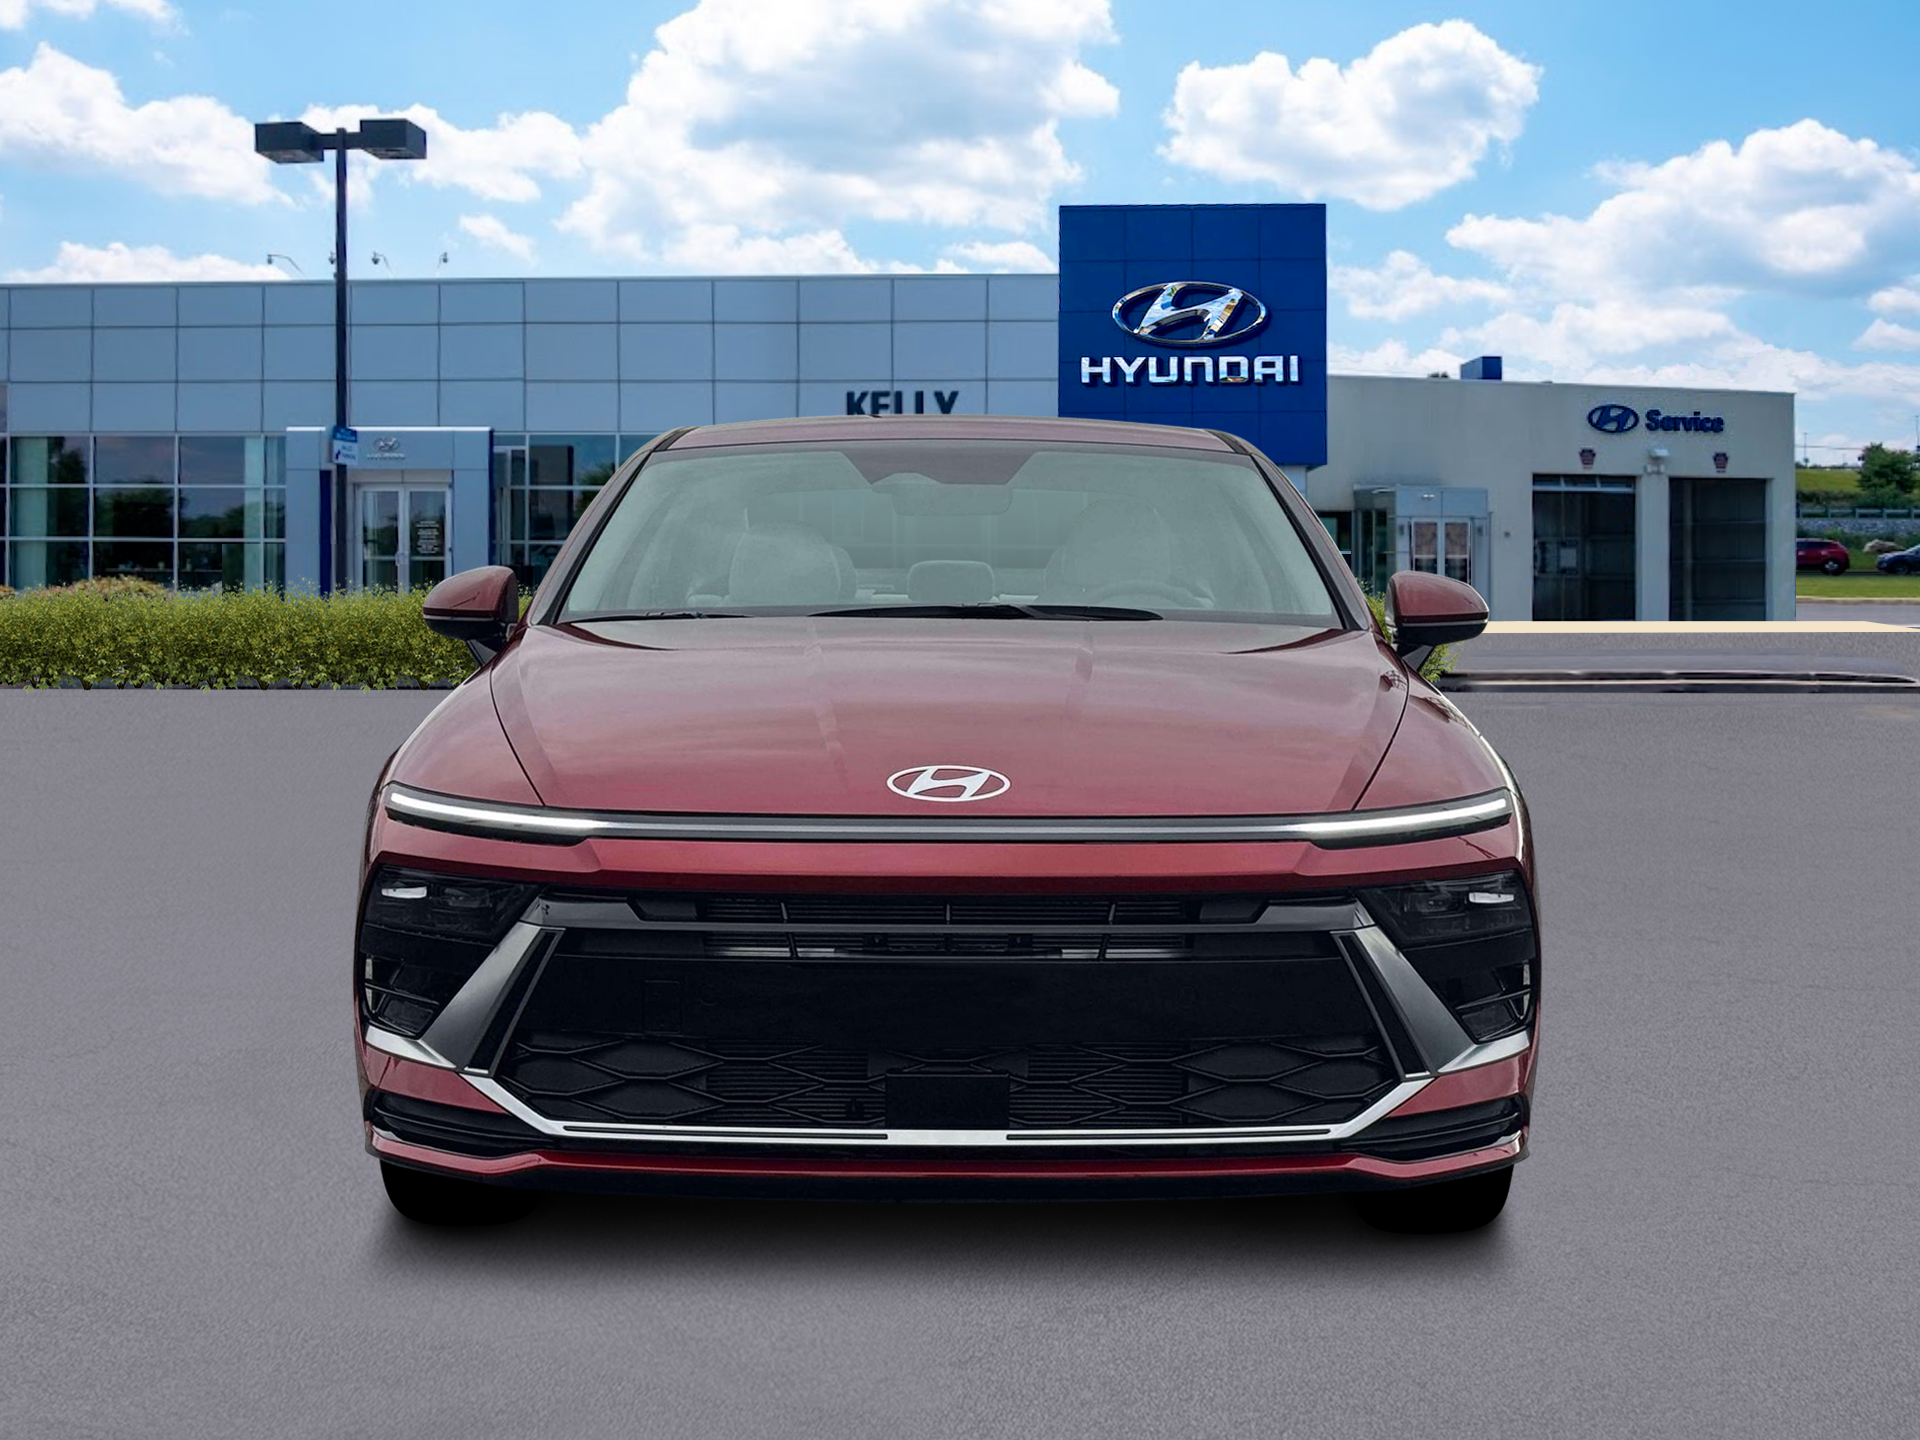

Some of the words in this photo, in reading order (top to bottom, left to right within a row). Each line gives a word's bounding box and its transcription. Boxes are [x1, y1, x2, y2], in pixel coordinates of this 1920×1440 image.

[1080, 355, 1299, 384] HYUNDAI
[846, 390, 959, 415] KELLY
[1645, 409, 1724, 432] Service
